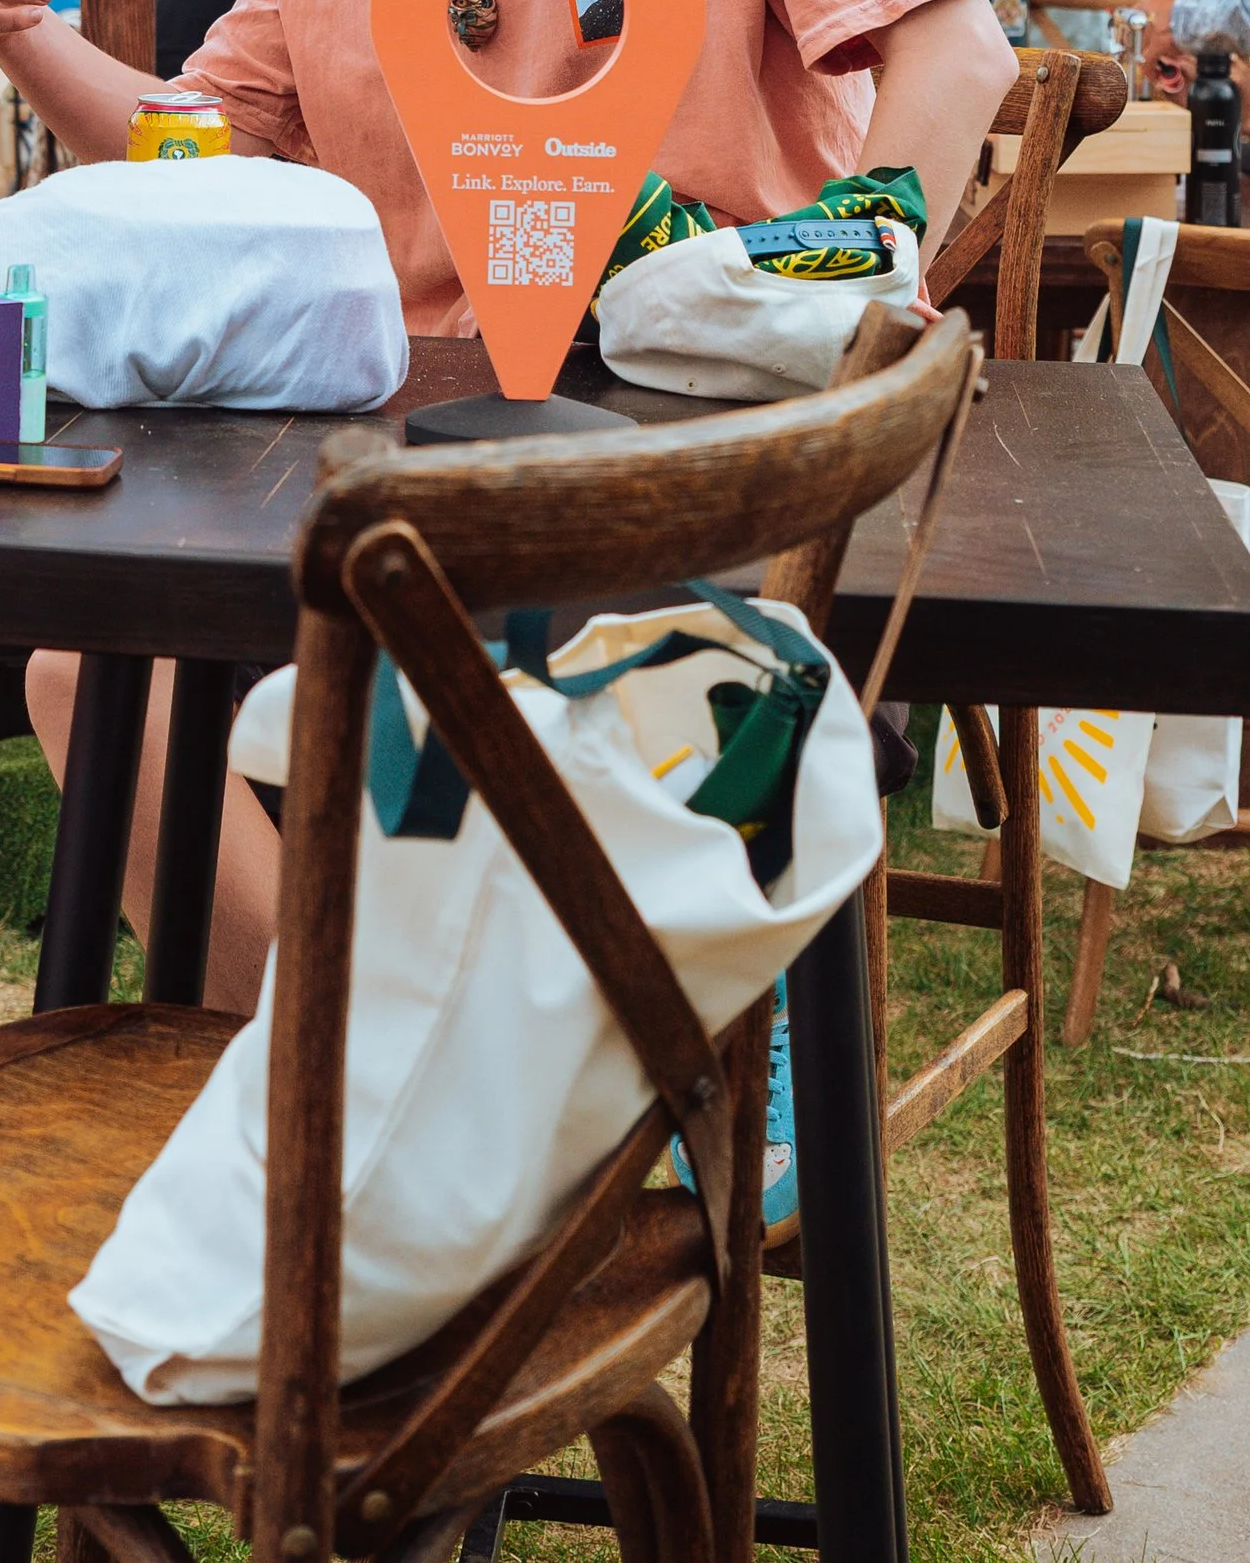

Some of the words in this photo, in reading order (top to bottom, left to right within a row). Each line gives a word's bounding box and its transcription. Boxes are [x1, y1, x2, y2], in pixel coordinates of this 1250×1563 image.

[461, 133, 514, 142] MARRIOTT
[544, 137, 617, 158] Outside
[452, 174, 496, 190] Link.
[500, 175, 567, 195] Explore.
[571, 176, 615, 193] Earn.
